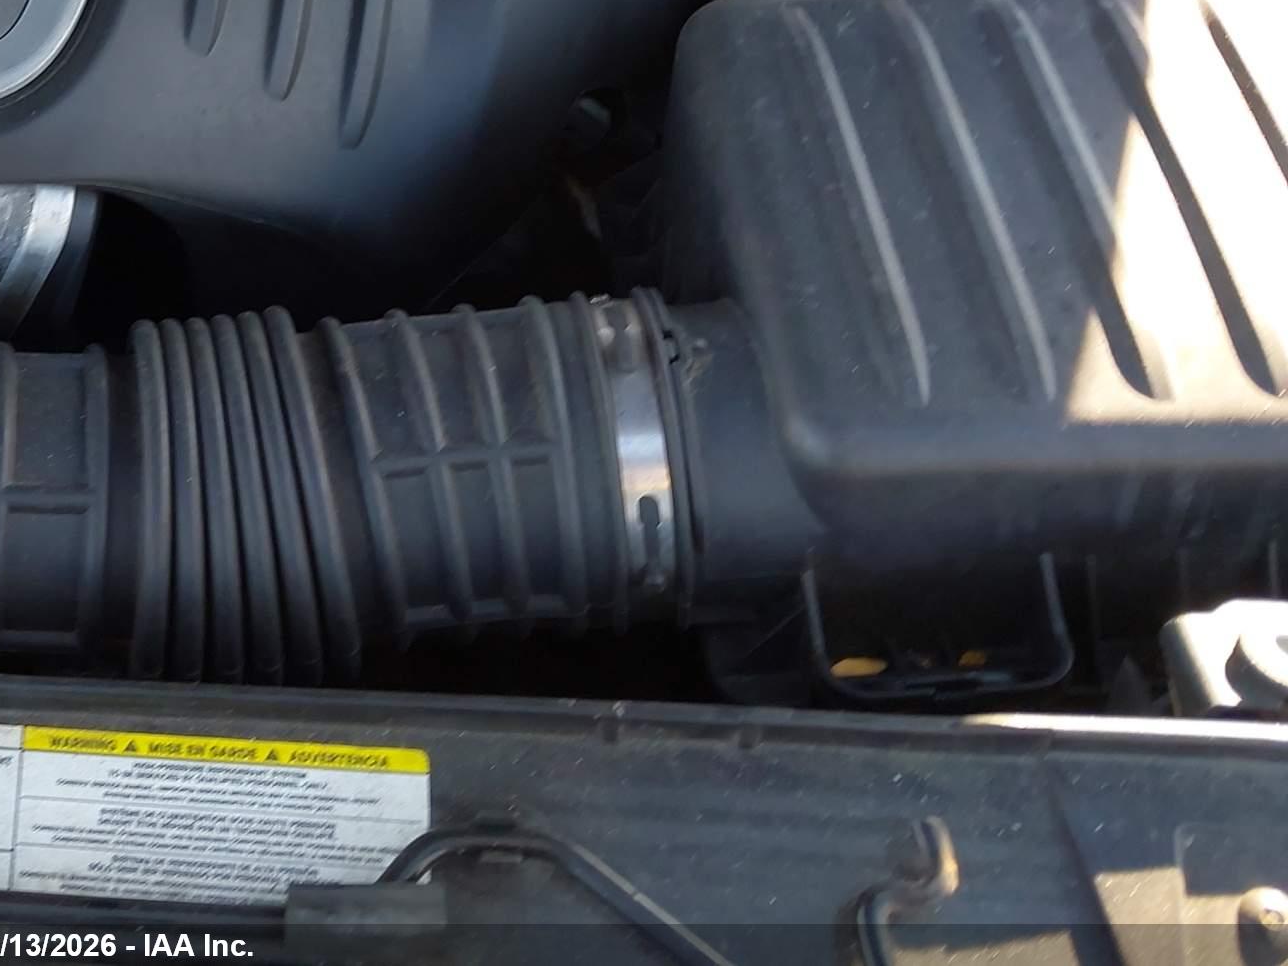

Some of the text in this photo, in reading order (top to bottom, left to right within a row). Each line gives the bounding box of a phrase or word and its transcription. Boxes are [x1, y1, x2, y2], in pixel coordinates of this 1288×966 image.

[49, 736, 117, 752] WARNING
[209, 746, 257, 760] GARDE
[287, 749, 389, 768] ADVERTENCIA
